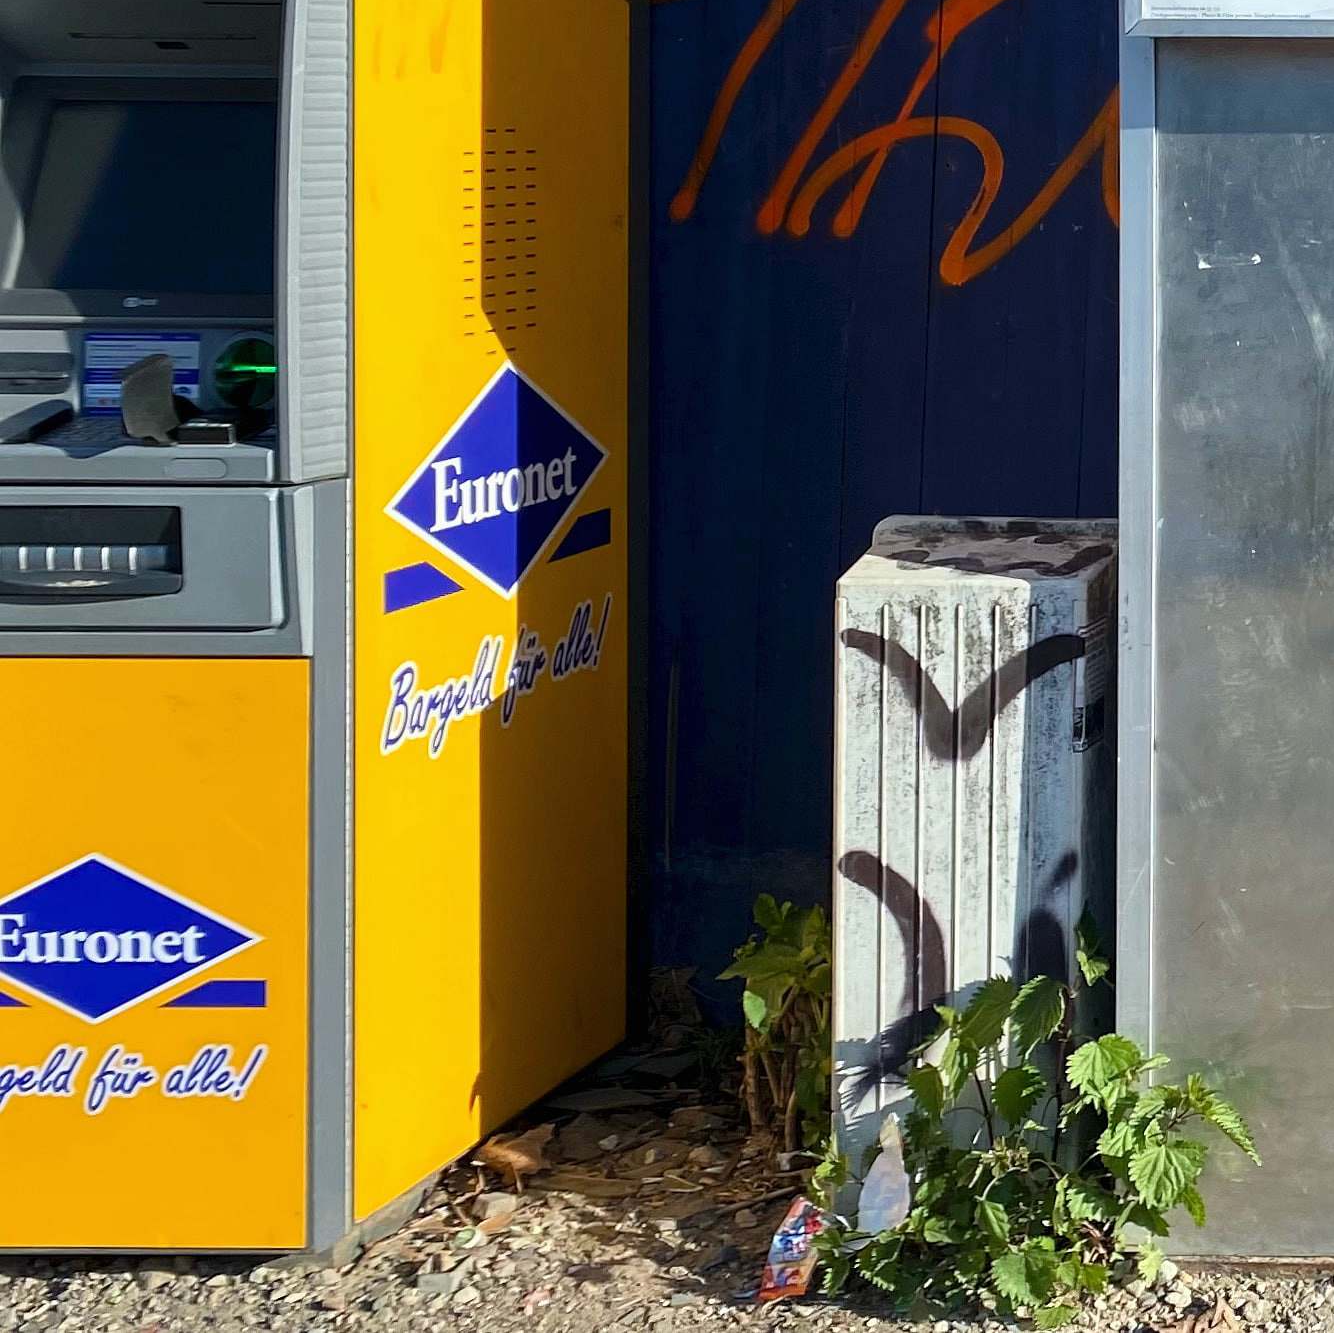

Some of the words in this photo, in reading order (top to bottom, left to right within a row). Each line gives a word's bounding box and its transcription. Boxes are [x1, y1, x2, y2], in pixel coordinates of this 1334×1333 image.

[430, 446, 577, 532] Euronet
[383, 639, 502, 753] Bargeld
[503, 627, 546, 723] für
[553, 595, 611, 676] alle!
[0, 913, 206, 963] Euronet
[89, 1048, 153, 1111] für
[166, 1048, 264, 1097] alle!
